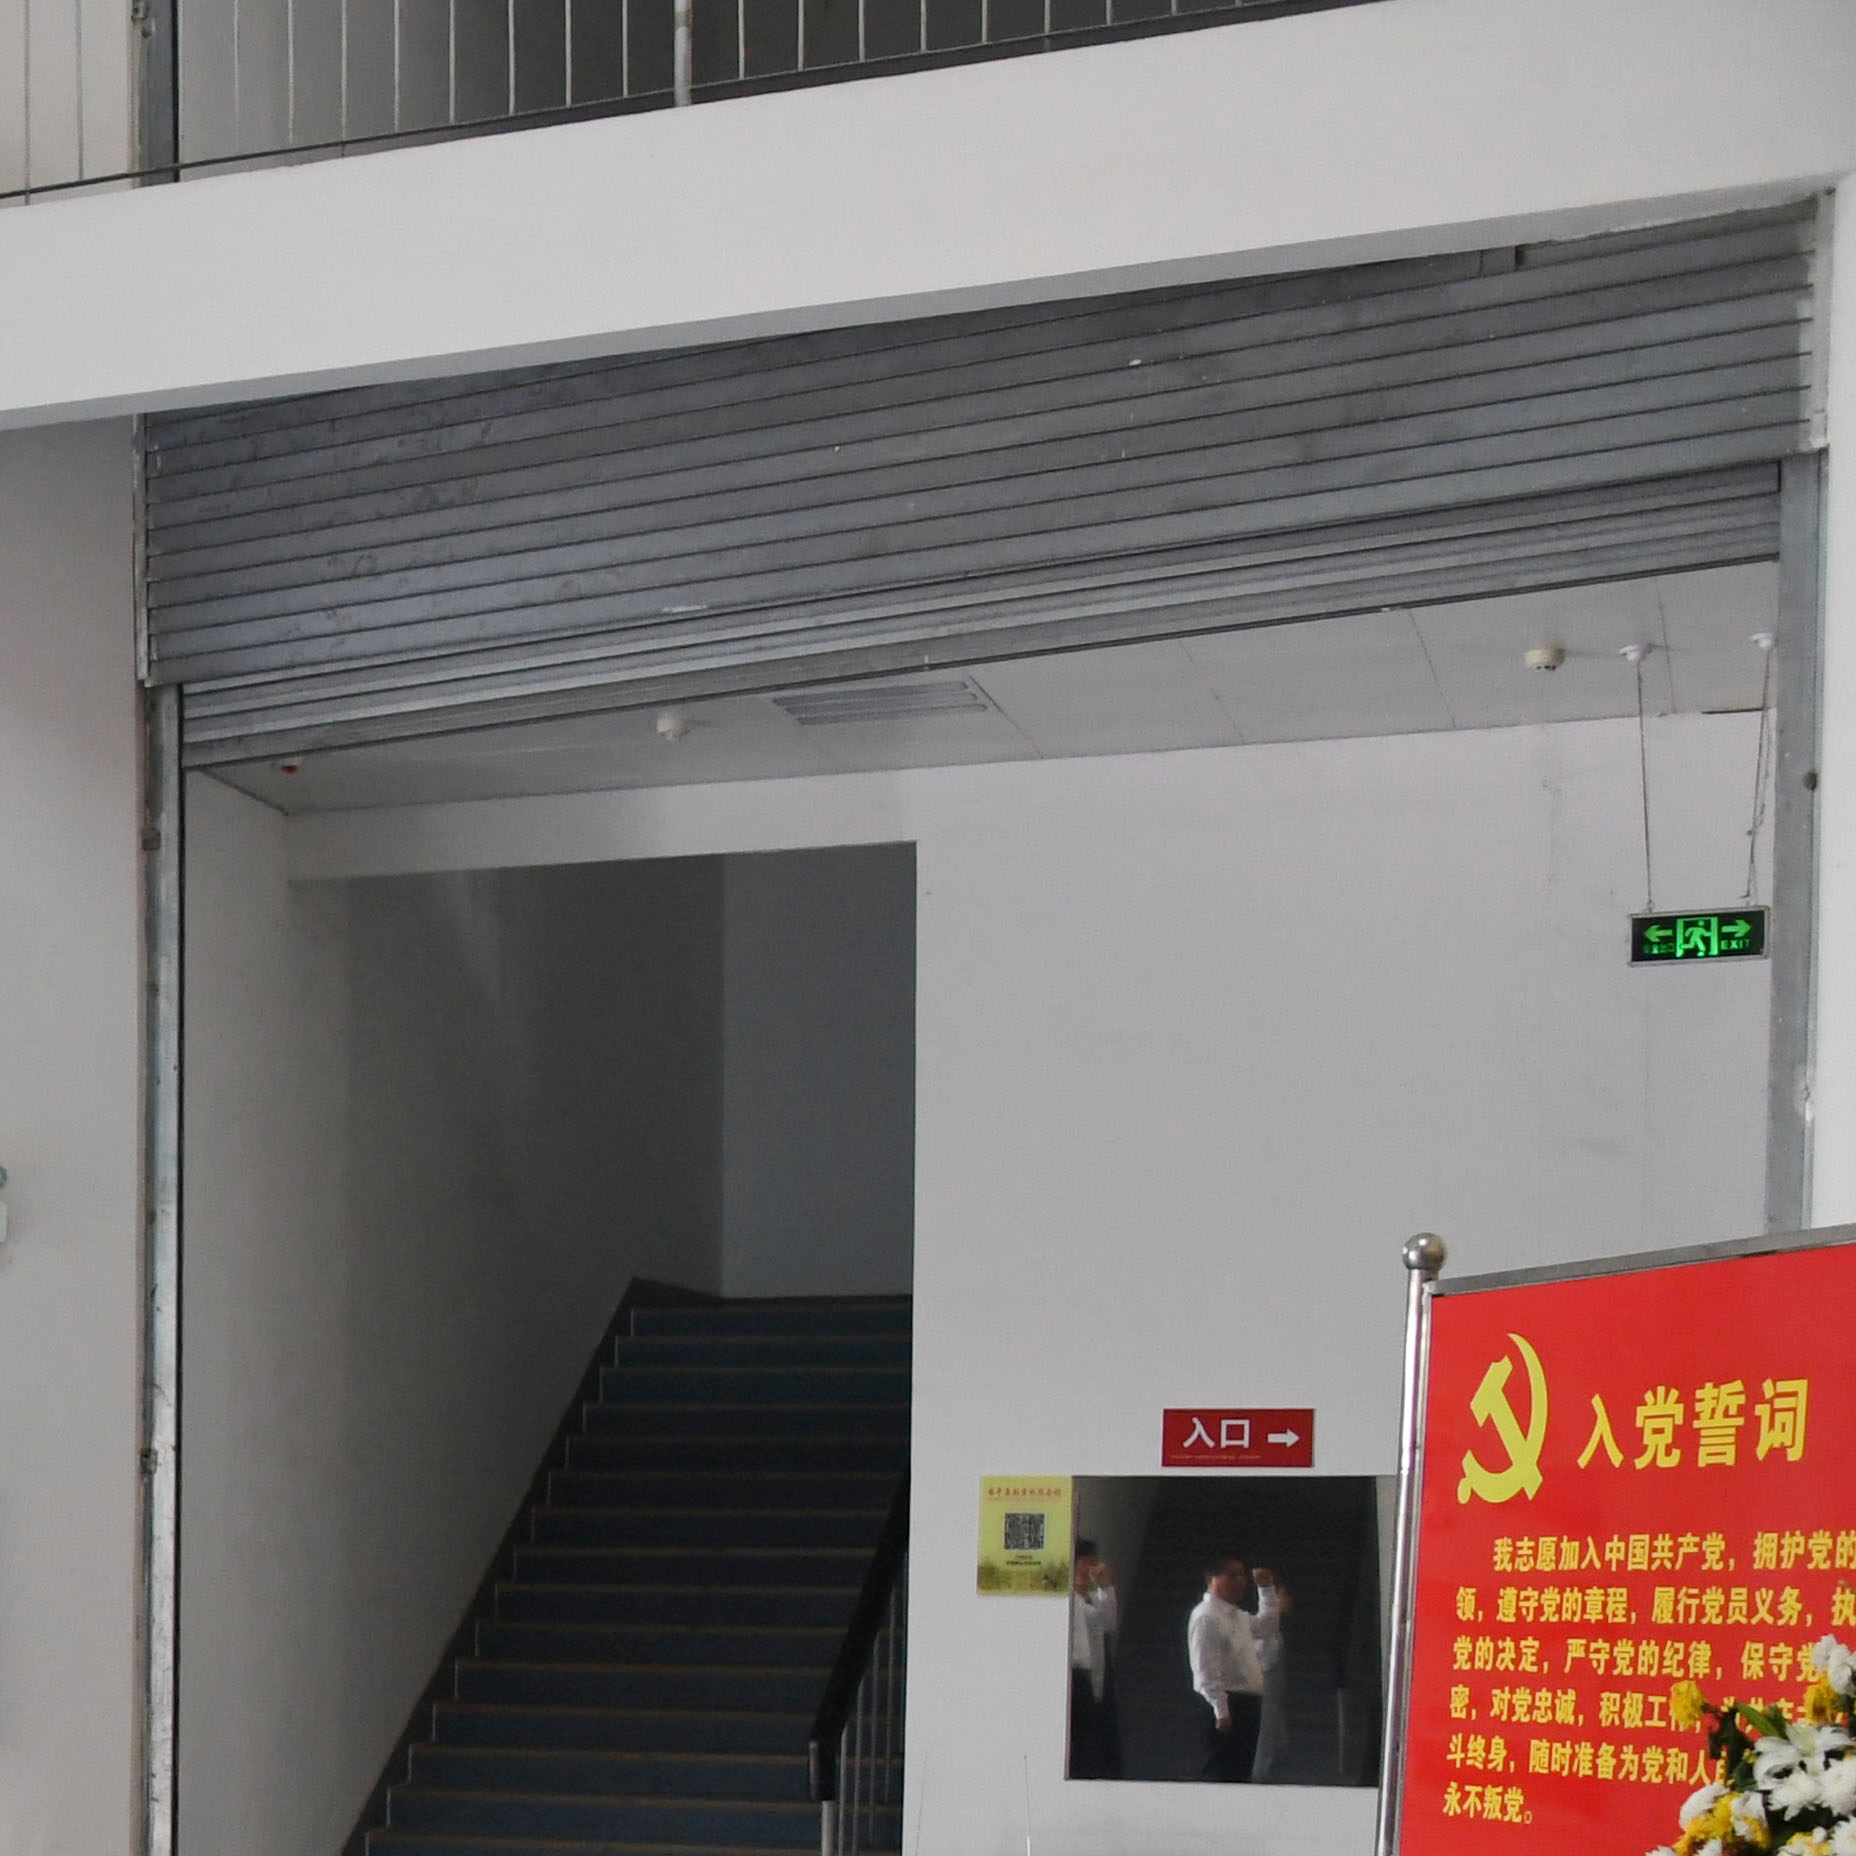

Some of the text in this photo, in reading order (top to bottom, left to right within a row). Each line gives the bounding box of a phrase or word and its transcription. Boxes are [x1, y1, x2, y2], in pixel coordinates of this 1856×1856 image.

[1720, 939, 1751, 951] EXIT
[1183, 1417, 1250, 1448] 入口
[1577, 1378, 1808, 1469] 入党誓词
[1442, 1781, 1533, 1825] 永不叛党。
